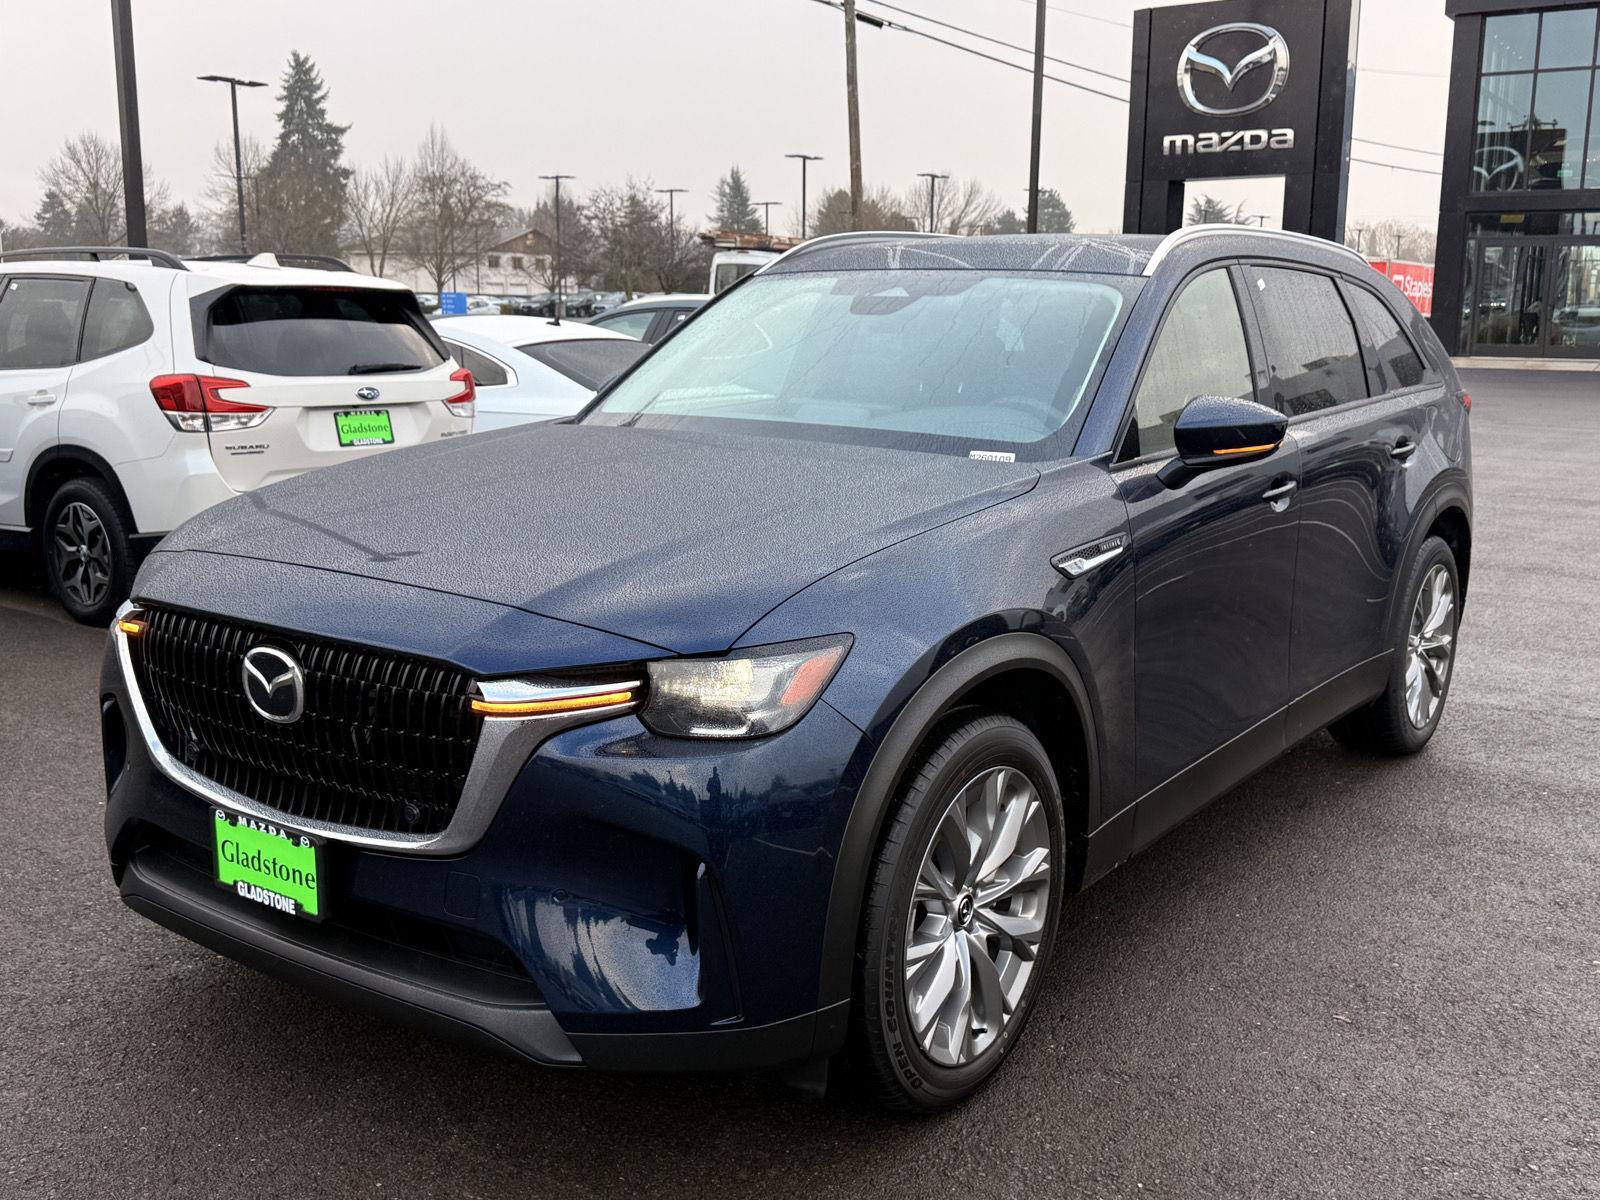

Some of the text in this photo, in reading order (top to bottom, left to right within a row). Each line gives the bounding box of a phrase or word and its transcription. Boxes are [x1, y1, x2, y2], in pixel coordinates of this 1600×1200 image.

[341, 423, 390, 435] Gladstone
[238, 815, 288, 840] MAZDA
[221, 839, 317, 890] Gladstone
[237, 881, 296, 915] GLADSTONE
[893, 1041, 924, 1090] OPEN
